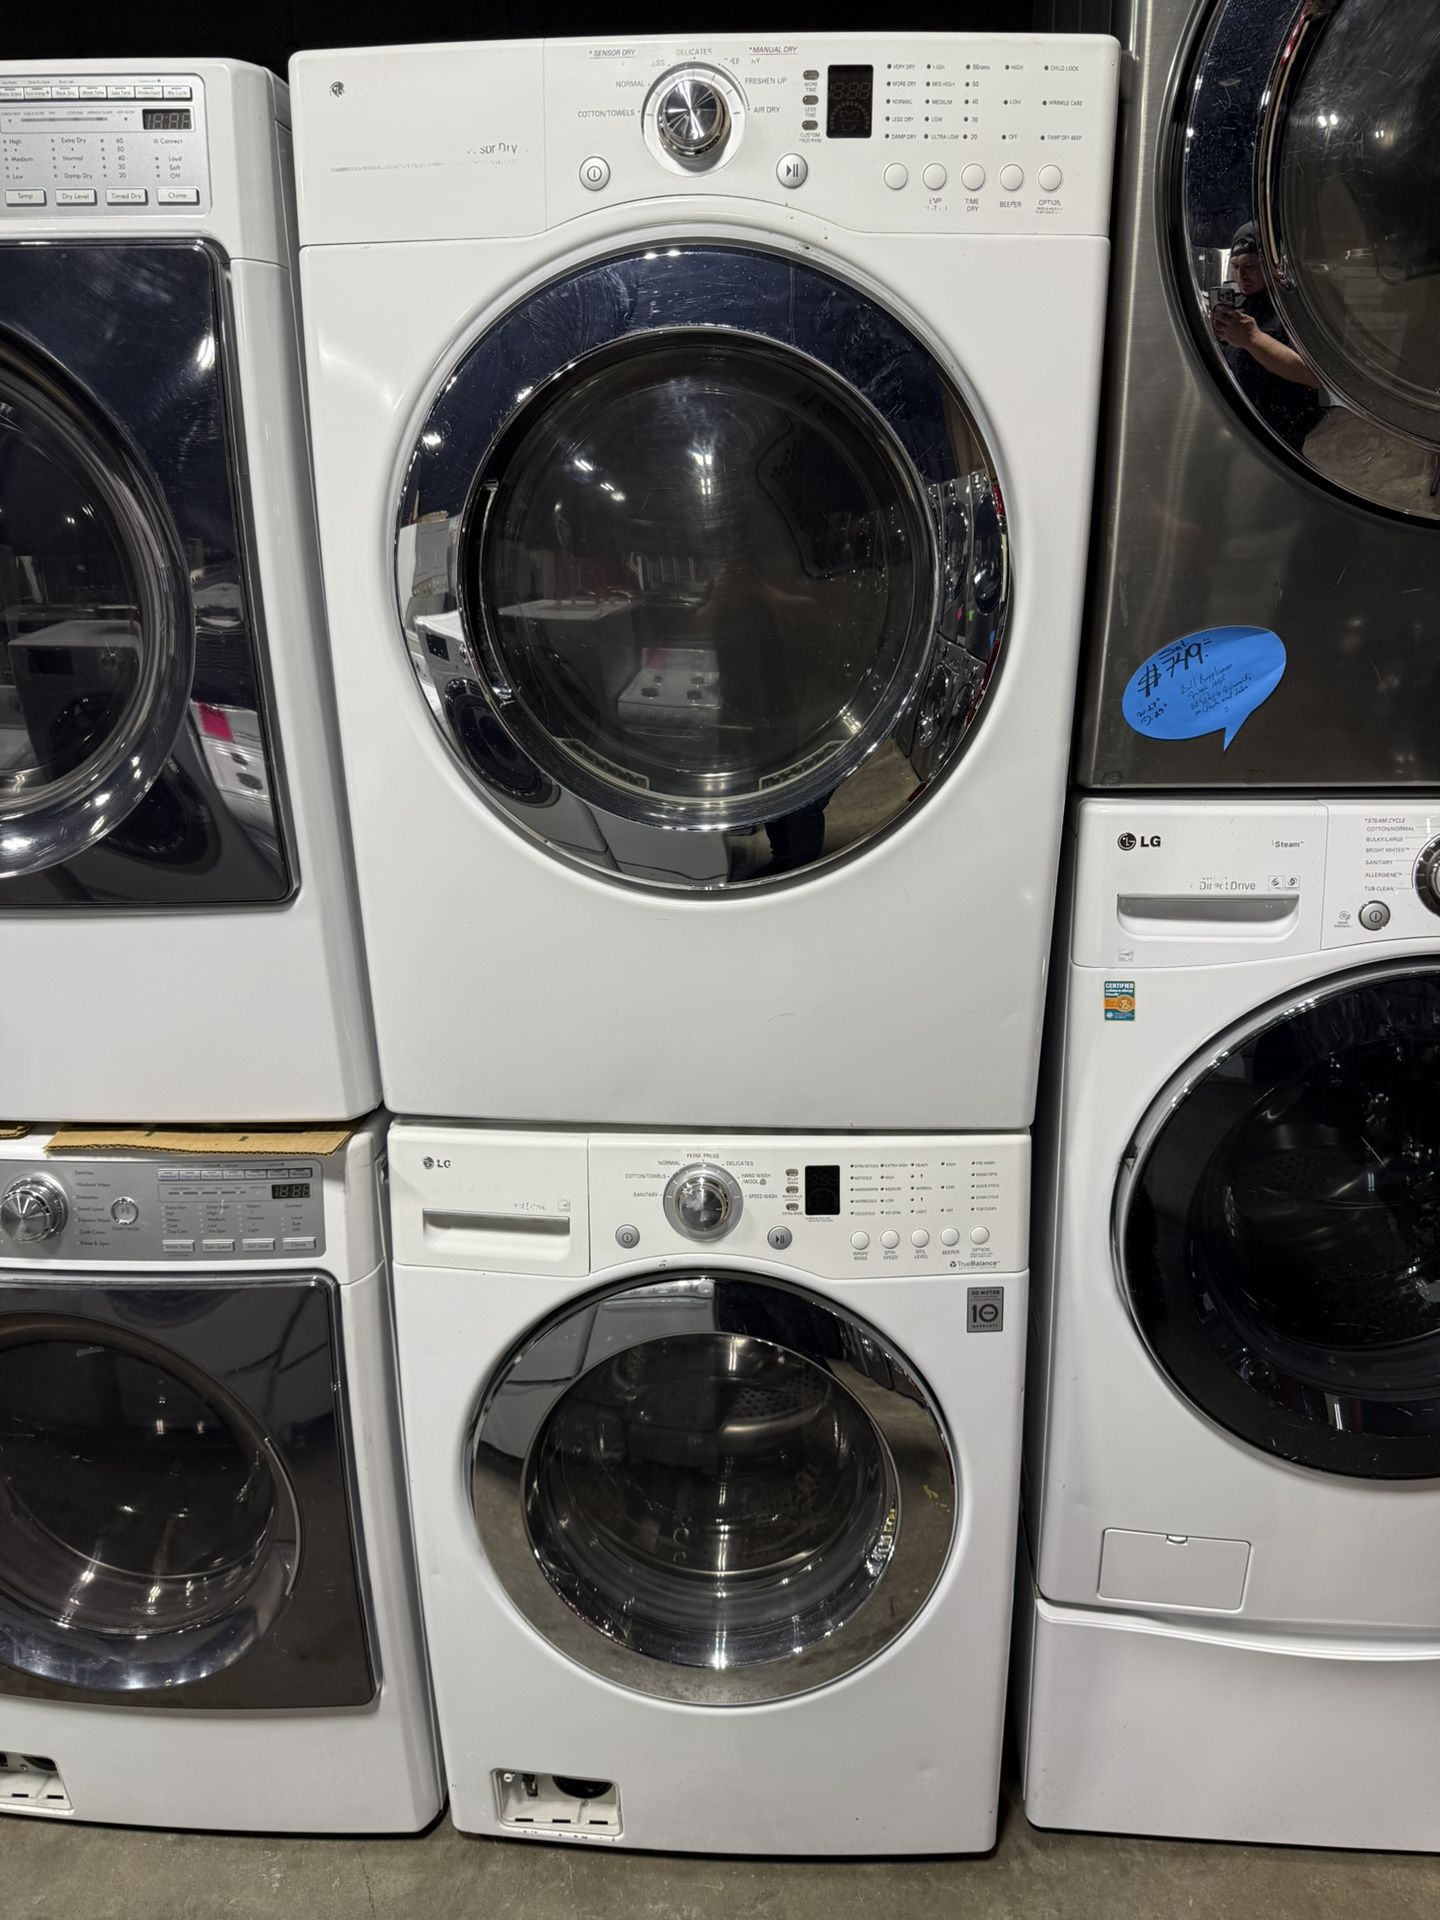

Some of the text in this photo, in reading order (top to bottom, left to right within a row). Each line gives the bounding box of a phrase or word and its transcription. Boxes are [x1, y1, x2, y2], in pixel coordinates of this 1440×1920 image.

[676, 48, 712, 56] DELICATES
[616, 80, 645, 88] NORMAL
[745, 77, 776, 85] FRESHEN
[578, 110, 635, 118] COTTON/TOWELS
[64, 172, 92, 180] Damp Dry
[1140, 835, 1161, 848] LG
[1231, 880, 1256, 890] Drive
[437, 1160, 451, 1168] LG
[972, 1303, 999, 1323] 10
